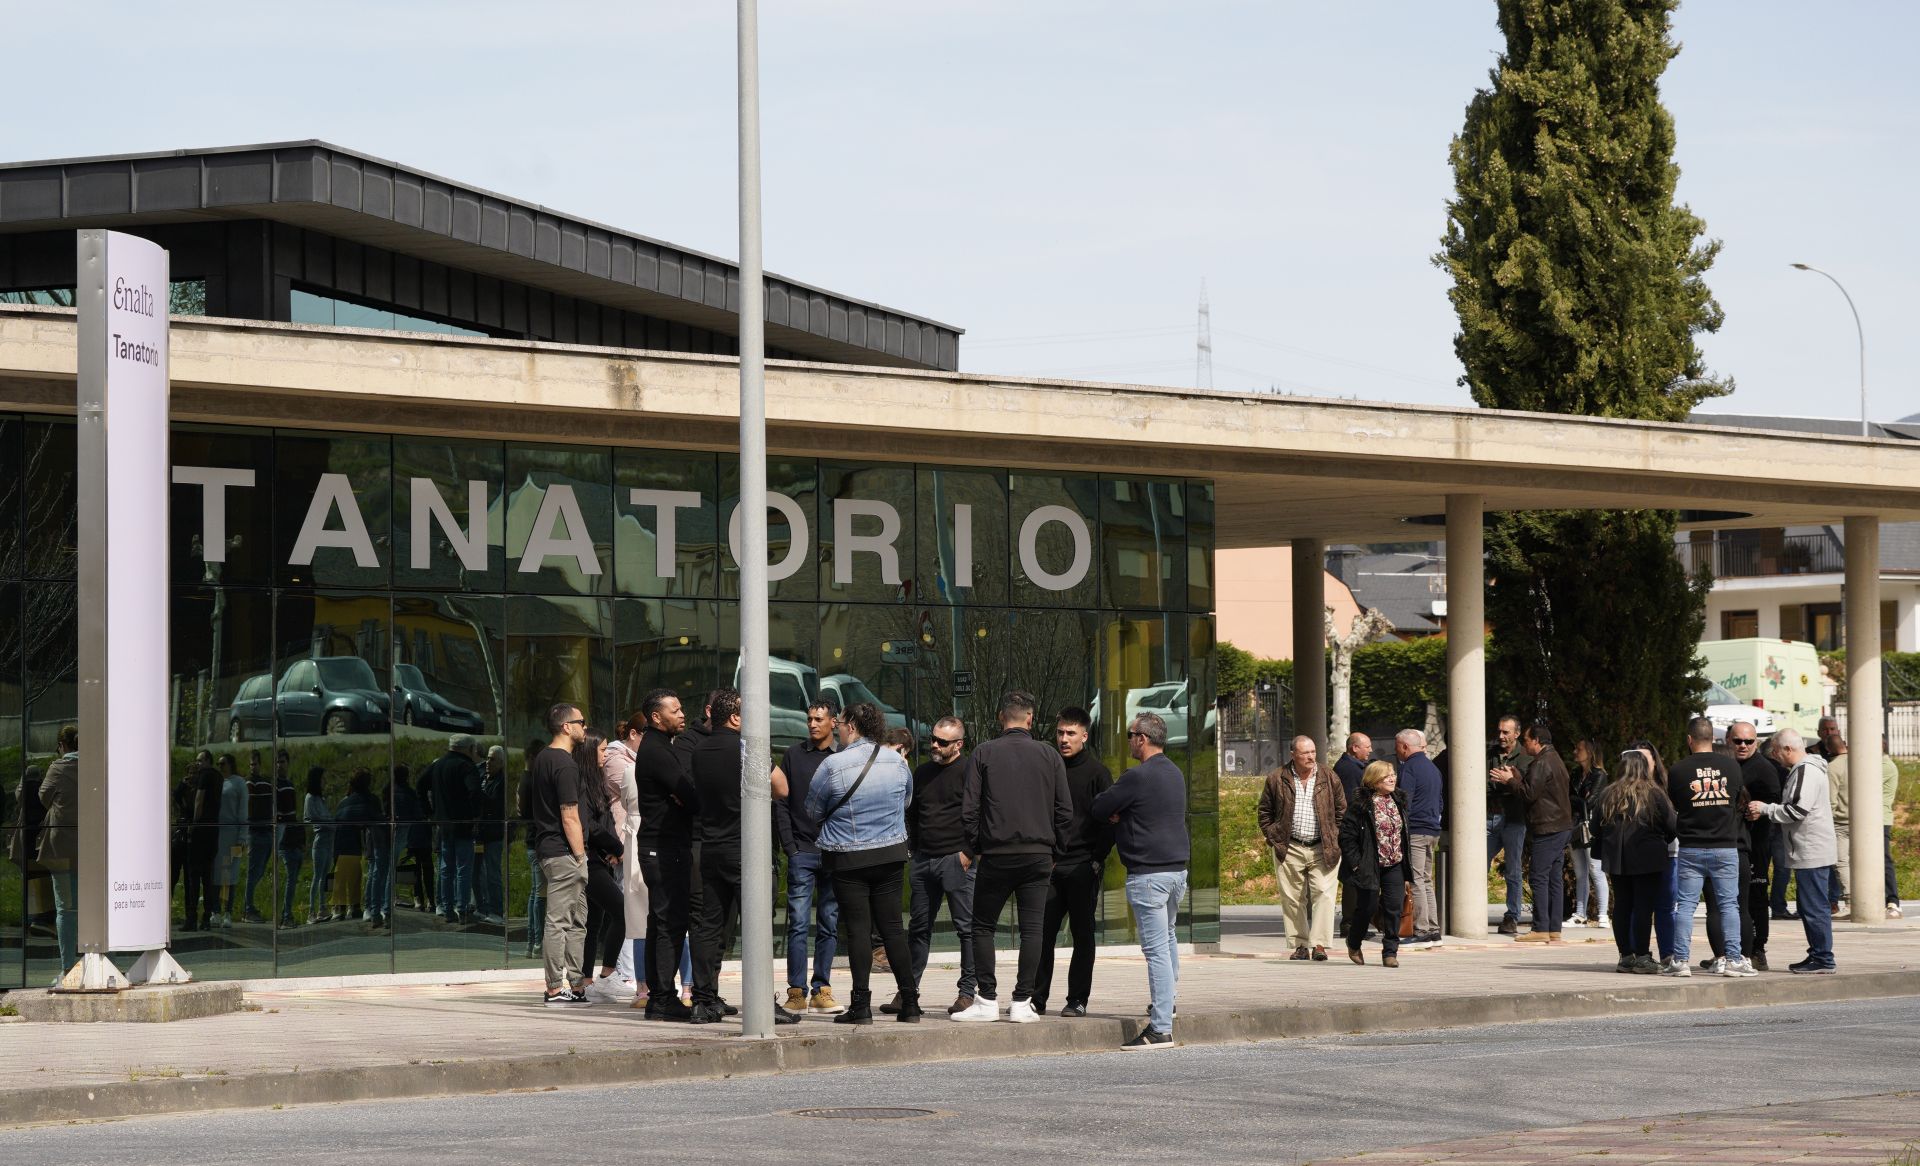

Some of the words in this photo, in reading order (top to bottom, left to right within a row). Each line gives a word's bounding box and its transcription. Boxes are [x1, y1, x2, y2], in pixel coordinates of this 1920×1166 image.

[113, 276, 154, 318] Enalta
[113, 333, 159, 367] Tanatorio
[172, 466, 1092, 591] TANATORIO
[113, 880, 128, 891] Cada
